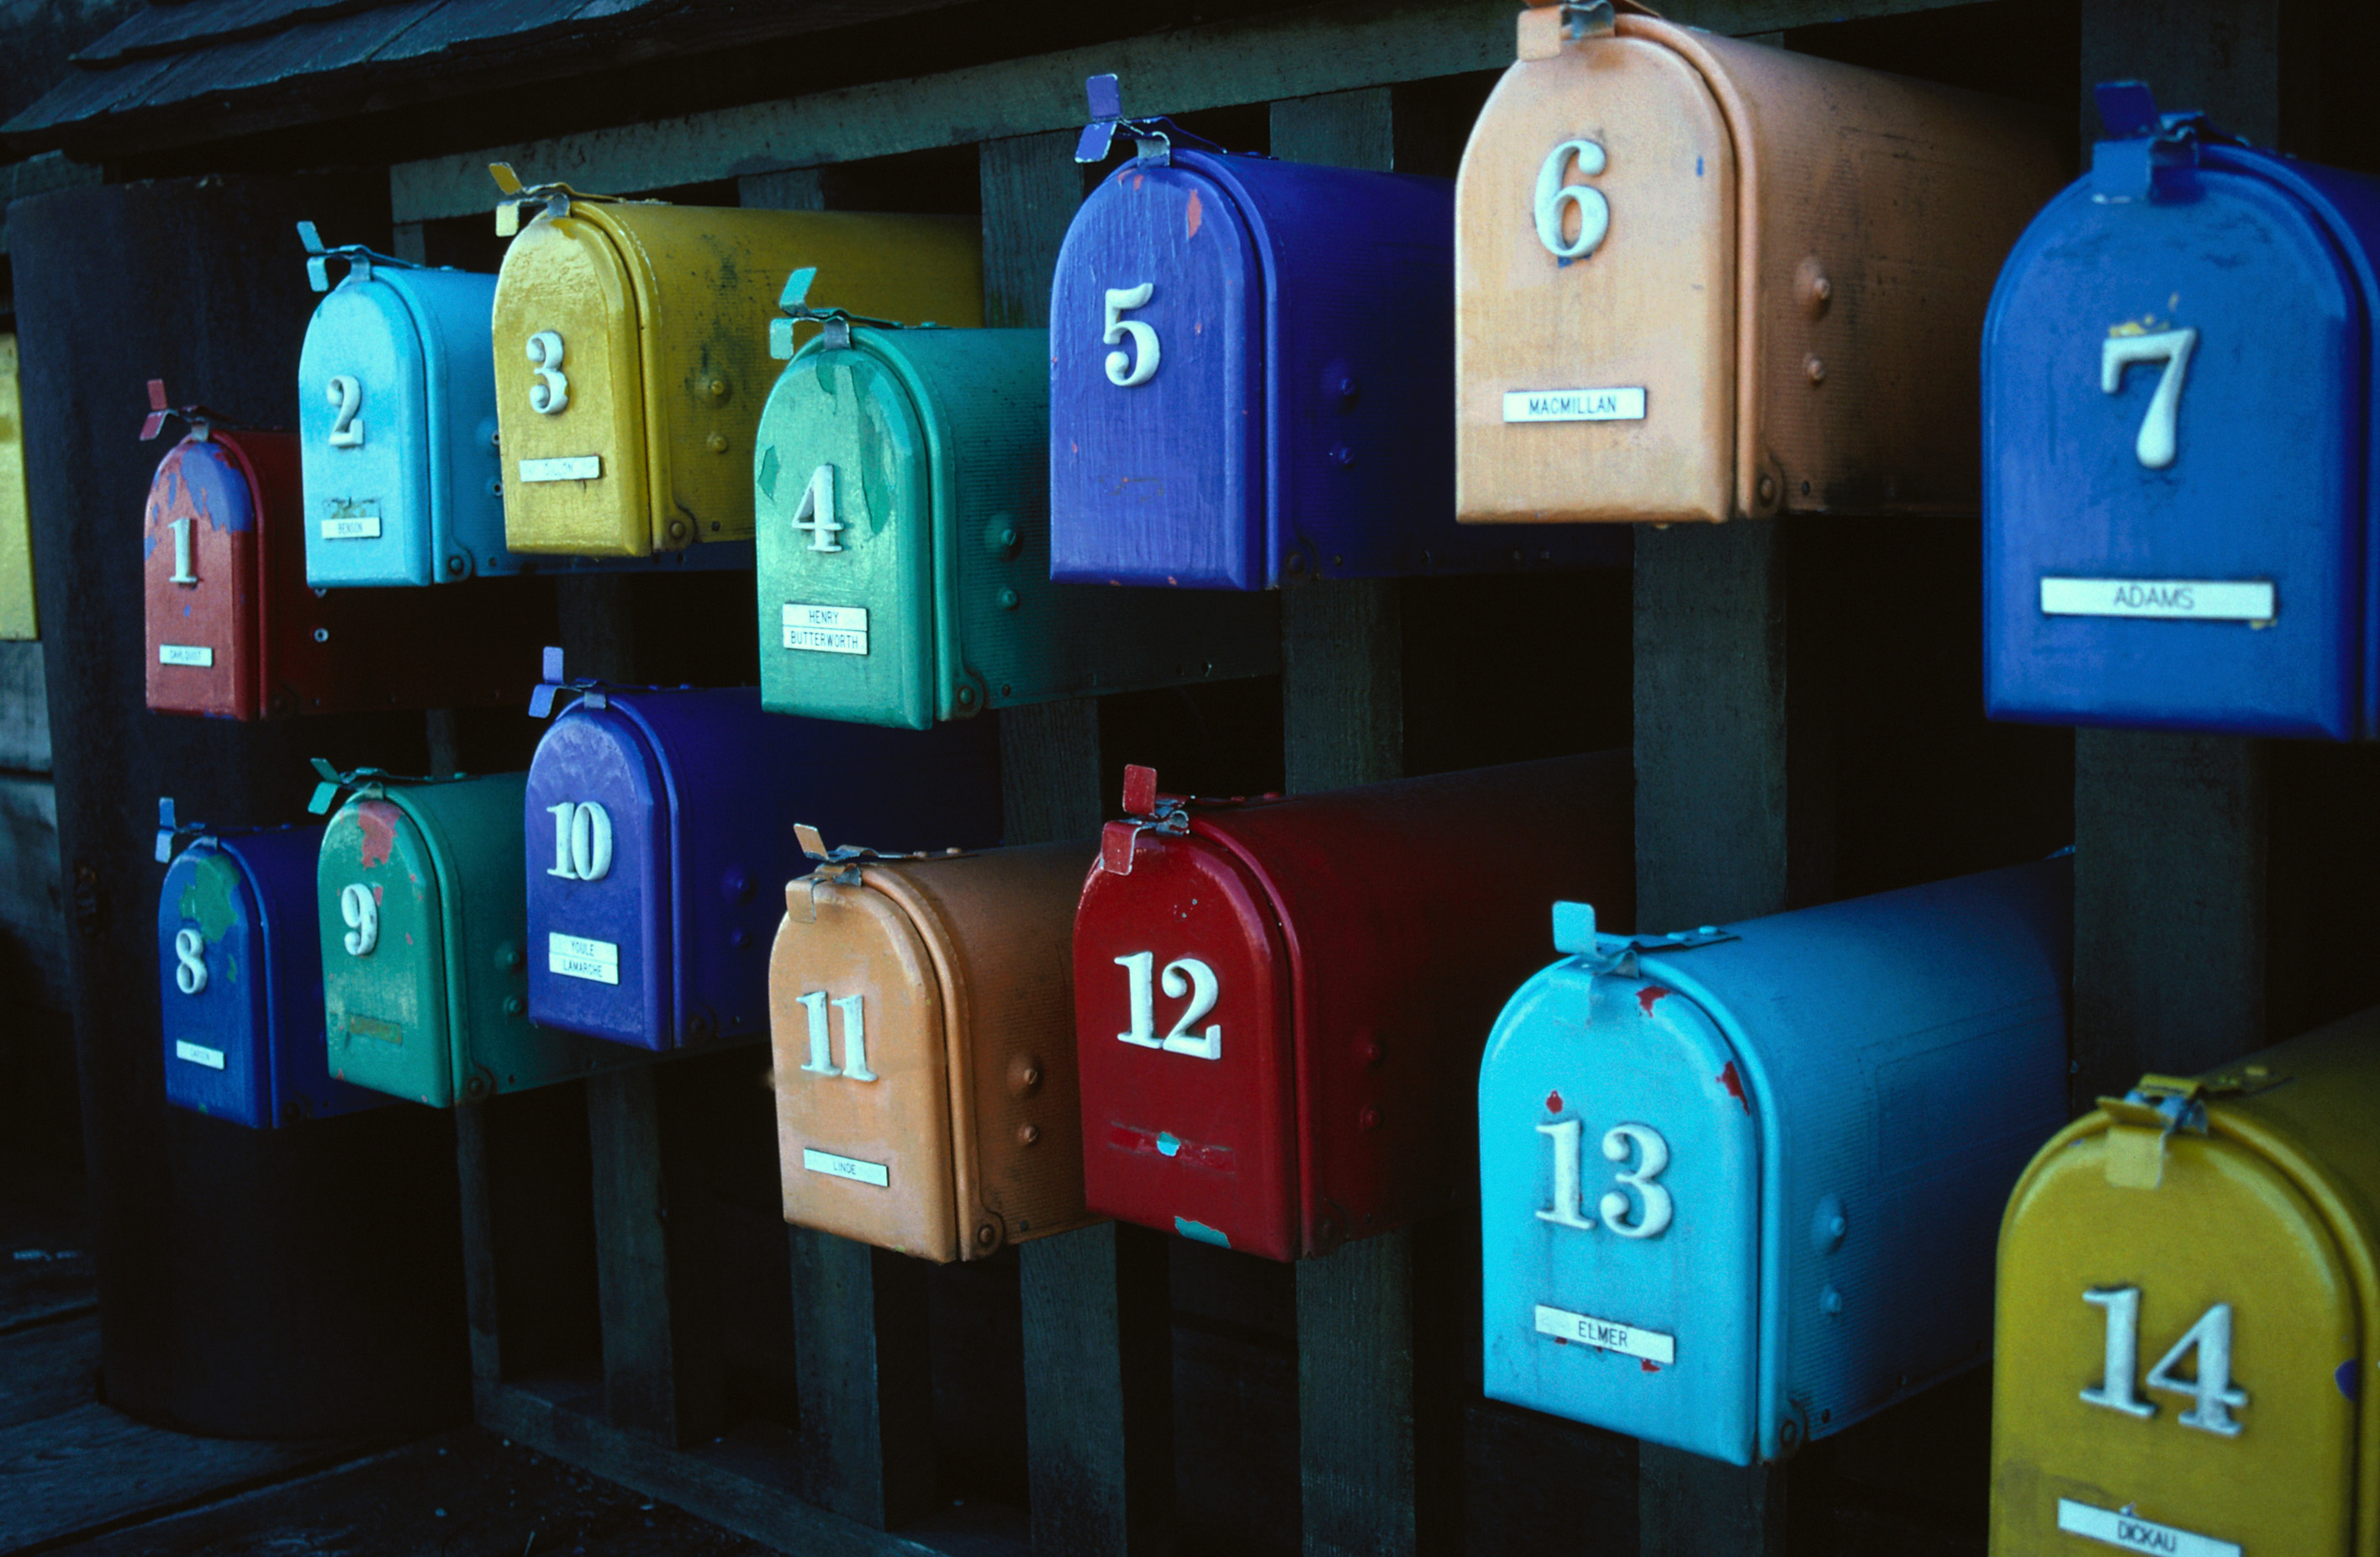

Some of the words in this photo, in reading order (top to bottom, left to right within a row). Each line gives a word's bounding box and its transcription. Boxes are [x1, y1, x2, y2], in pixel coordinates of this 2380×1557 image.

[1532, 138, 1609, 265] 6
[525, 330, 568, 414] 3
[1103, 282, 1162, 388] 5
[326, 375, 363, 447] 2
[1528, 394, 1617, 415] MACMILLAN
[2098, 326, 2197, 468] 7
[792, 463, 844, 553] 4
[168, 516, 198, 584] 1
[809, 609, 839, 625] HENRY
[2113, 584, 2195, 610] ADAMS
[790, 630, 858, 649] BUTTERWORTH
[546, 799, 614, 881] 10
[340, 882, 378, 957] 9
[175, 926, 207, 995] 8
[794, 990, 877, 1083] 11
[1113, 950, 1222, 1061] 12
[833, 1161, 857, 1175] LINDE
[1534, 1119, 1672, 1239] 13
[1578, 1320, 1628, 1347] ELMER
[2078, 1286, 2248, 1437] 14
[2118, 1520, 2177, 1553] DICKAU
